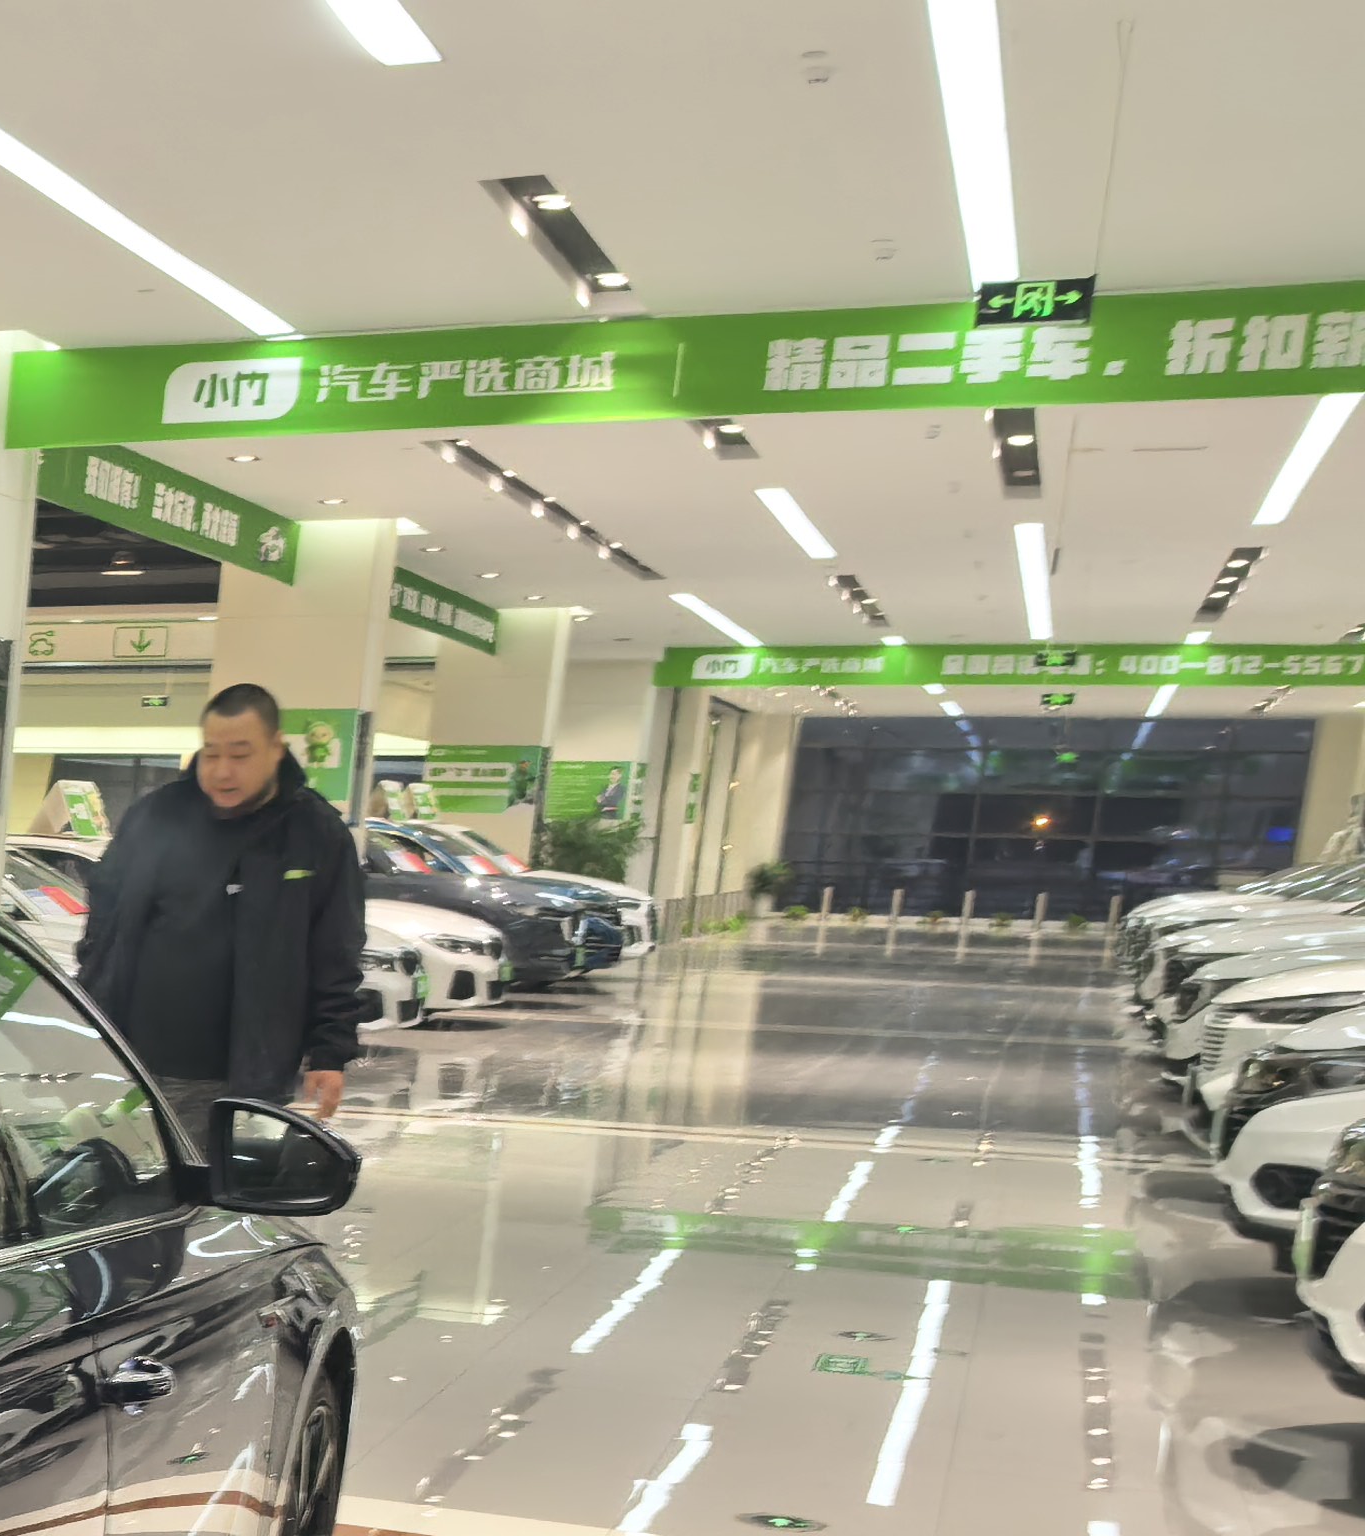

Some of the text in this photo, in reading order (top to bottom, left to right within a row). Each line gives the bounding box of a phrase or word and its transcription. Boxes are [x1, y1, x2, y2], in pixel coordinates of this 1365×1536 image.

[193, 350, 618, 409] 小竹 汽车严选商城
